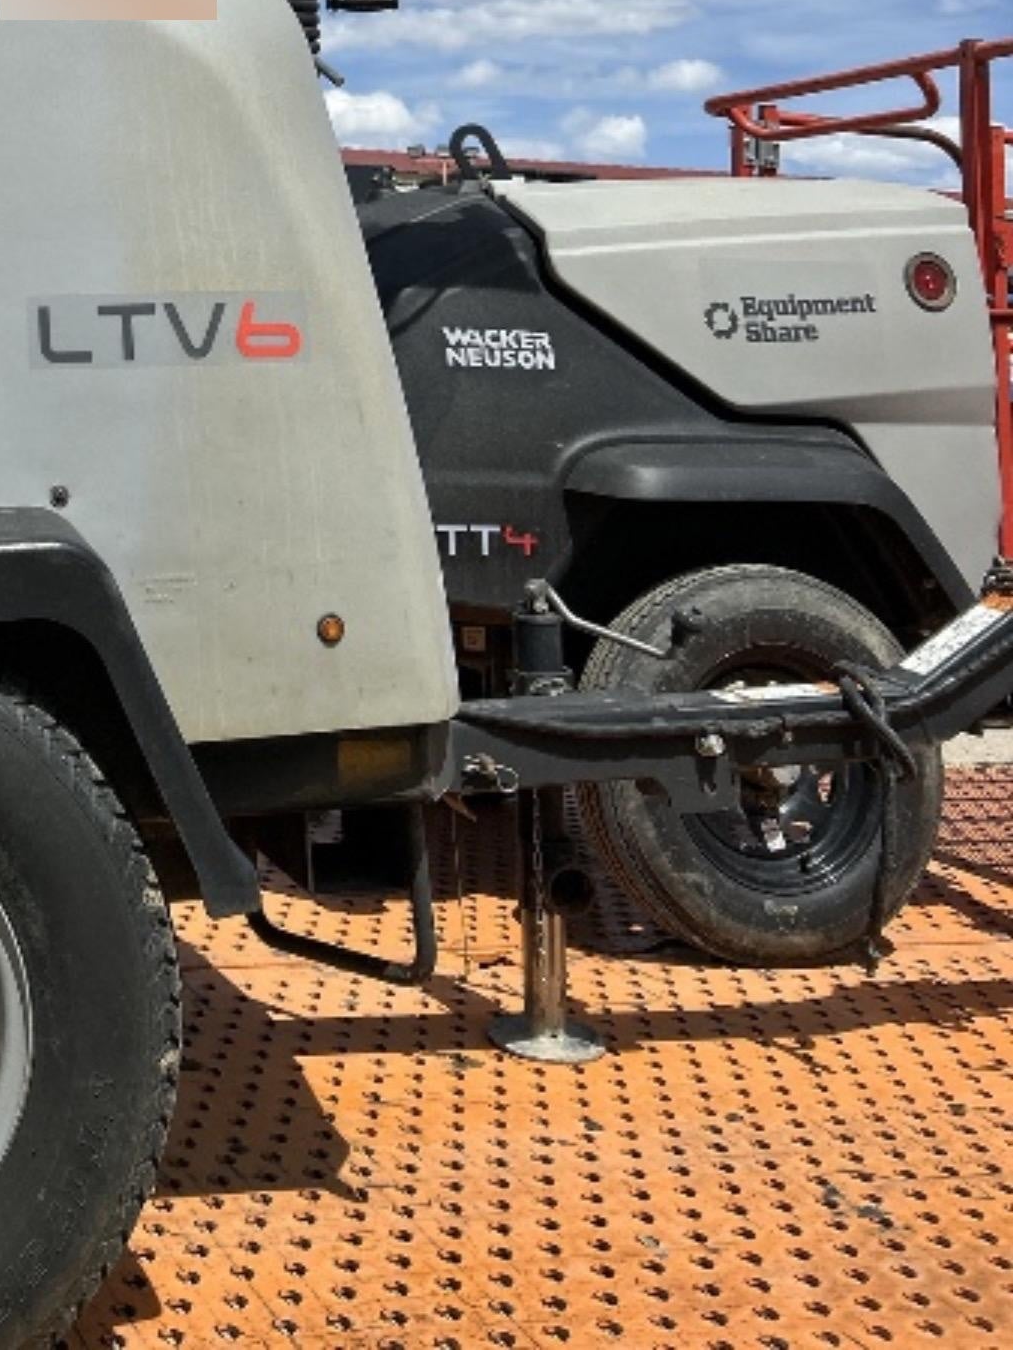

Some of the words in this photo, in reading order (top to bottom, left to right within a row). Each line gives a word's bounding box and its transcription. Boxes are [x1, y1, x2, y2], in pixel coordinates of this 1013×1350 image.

[740, 293, 876, 321] Equipment
[37, 300, 302, 363] LTV6
[442, 326, 552, 349] WACKER
[745, 321, 819, 342] Share
[445, 347, 555, 370] NEUSON
